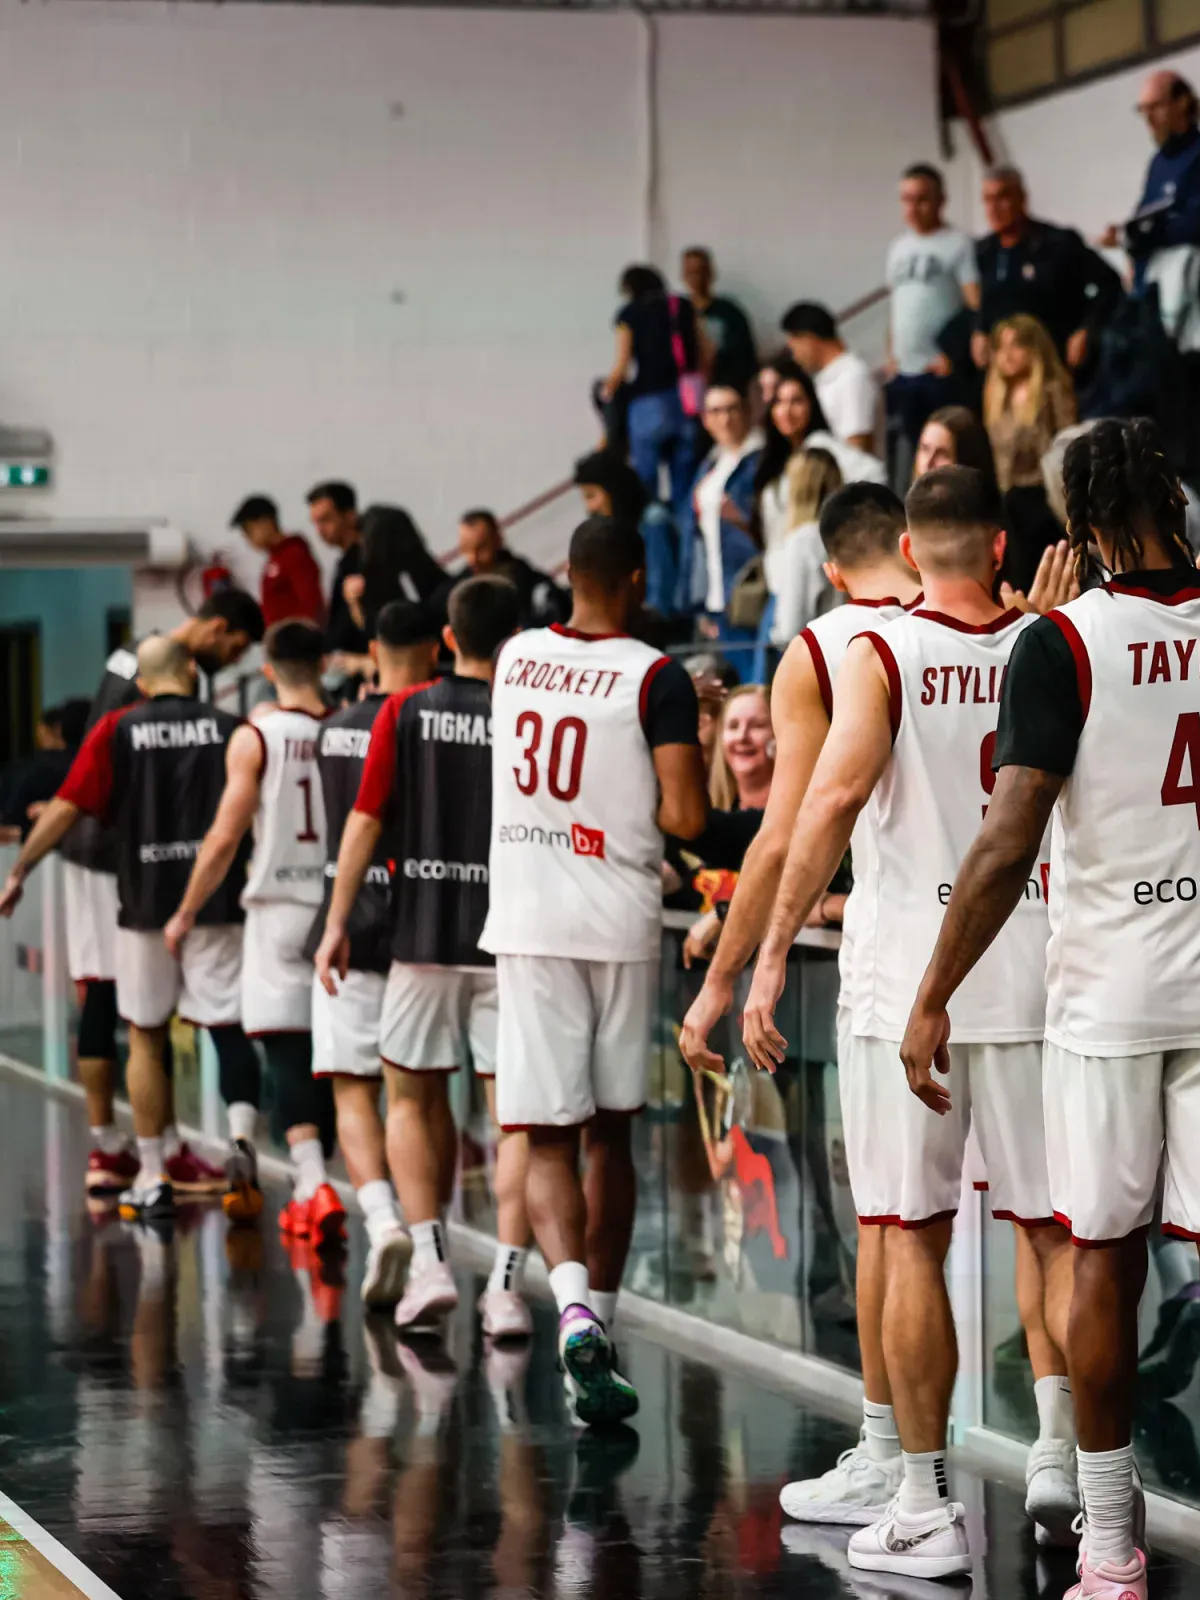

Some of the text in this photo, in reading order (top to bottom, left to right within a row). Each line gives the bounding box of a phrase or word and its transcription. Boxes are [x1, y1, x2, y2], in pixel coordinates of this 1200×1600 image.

[504, 658, 623, 699] CROCKETT
[512, 710, 588, 802] 30
[403, 858, 489, 884] ecomm
